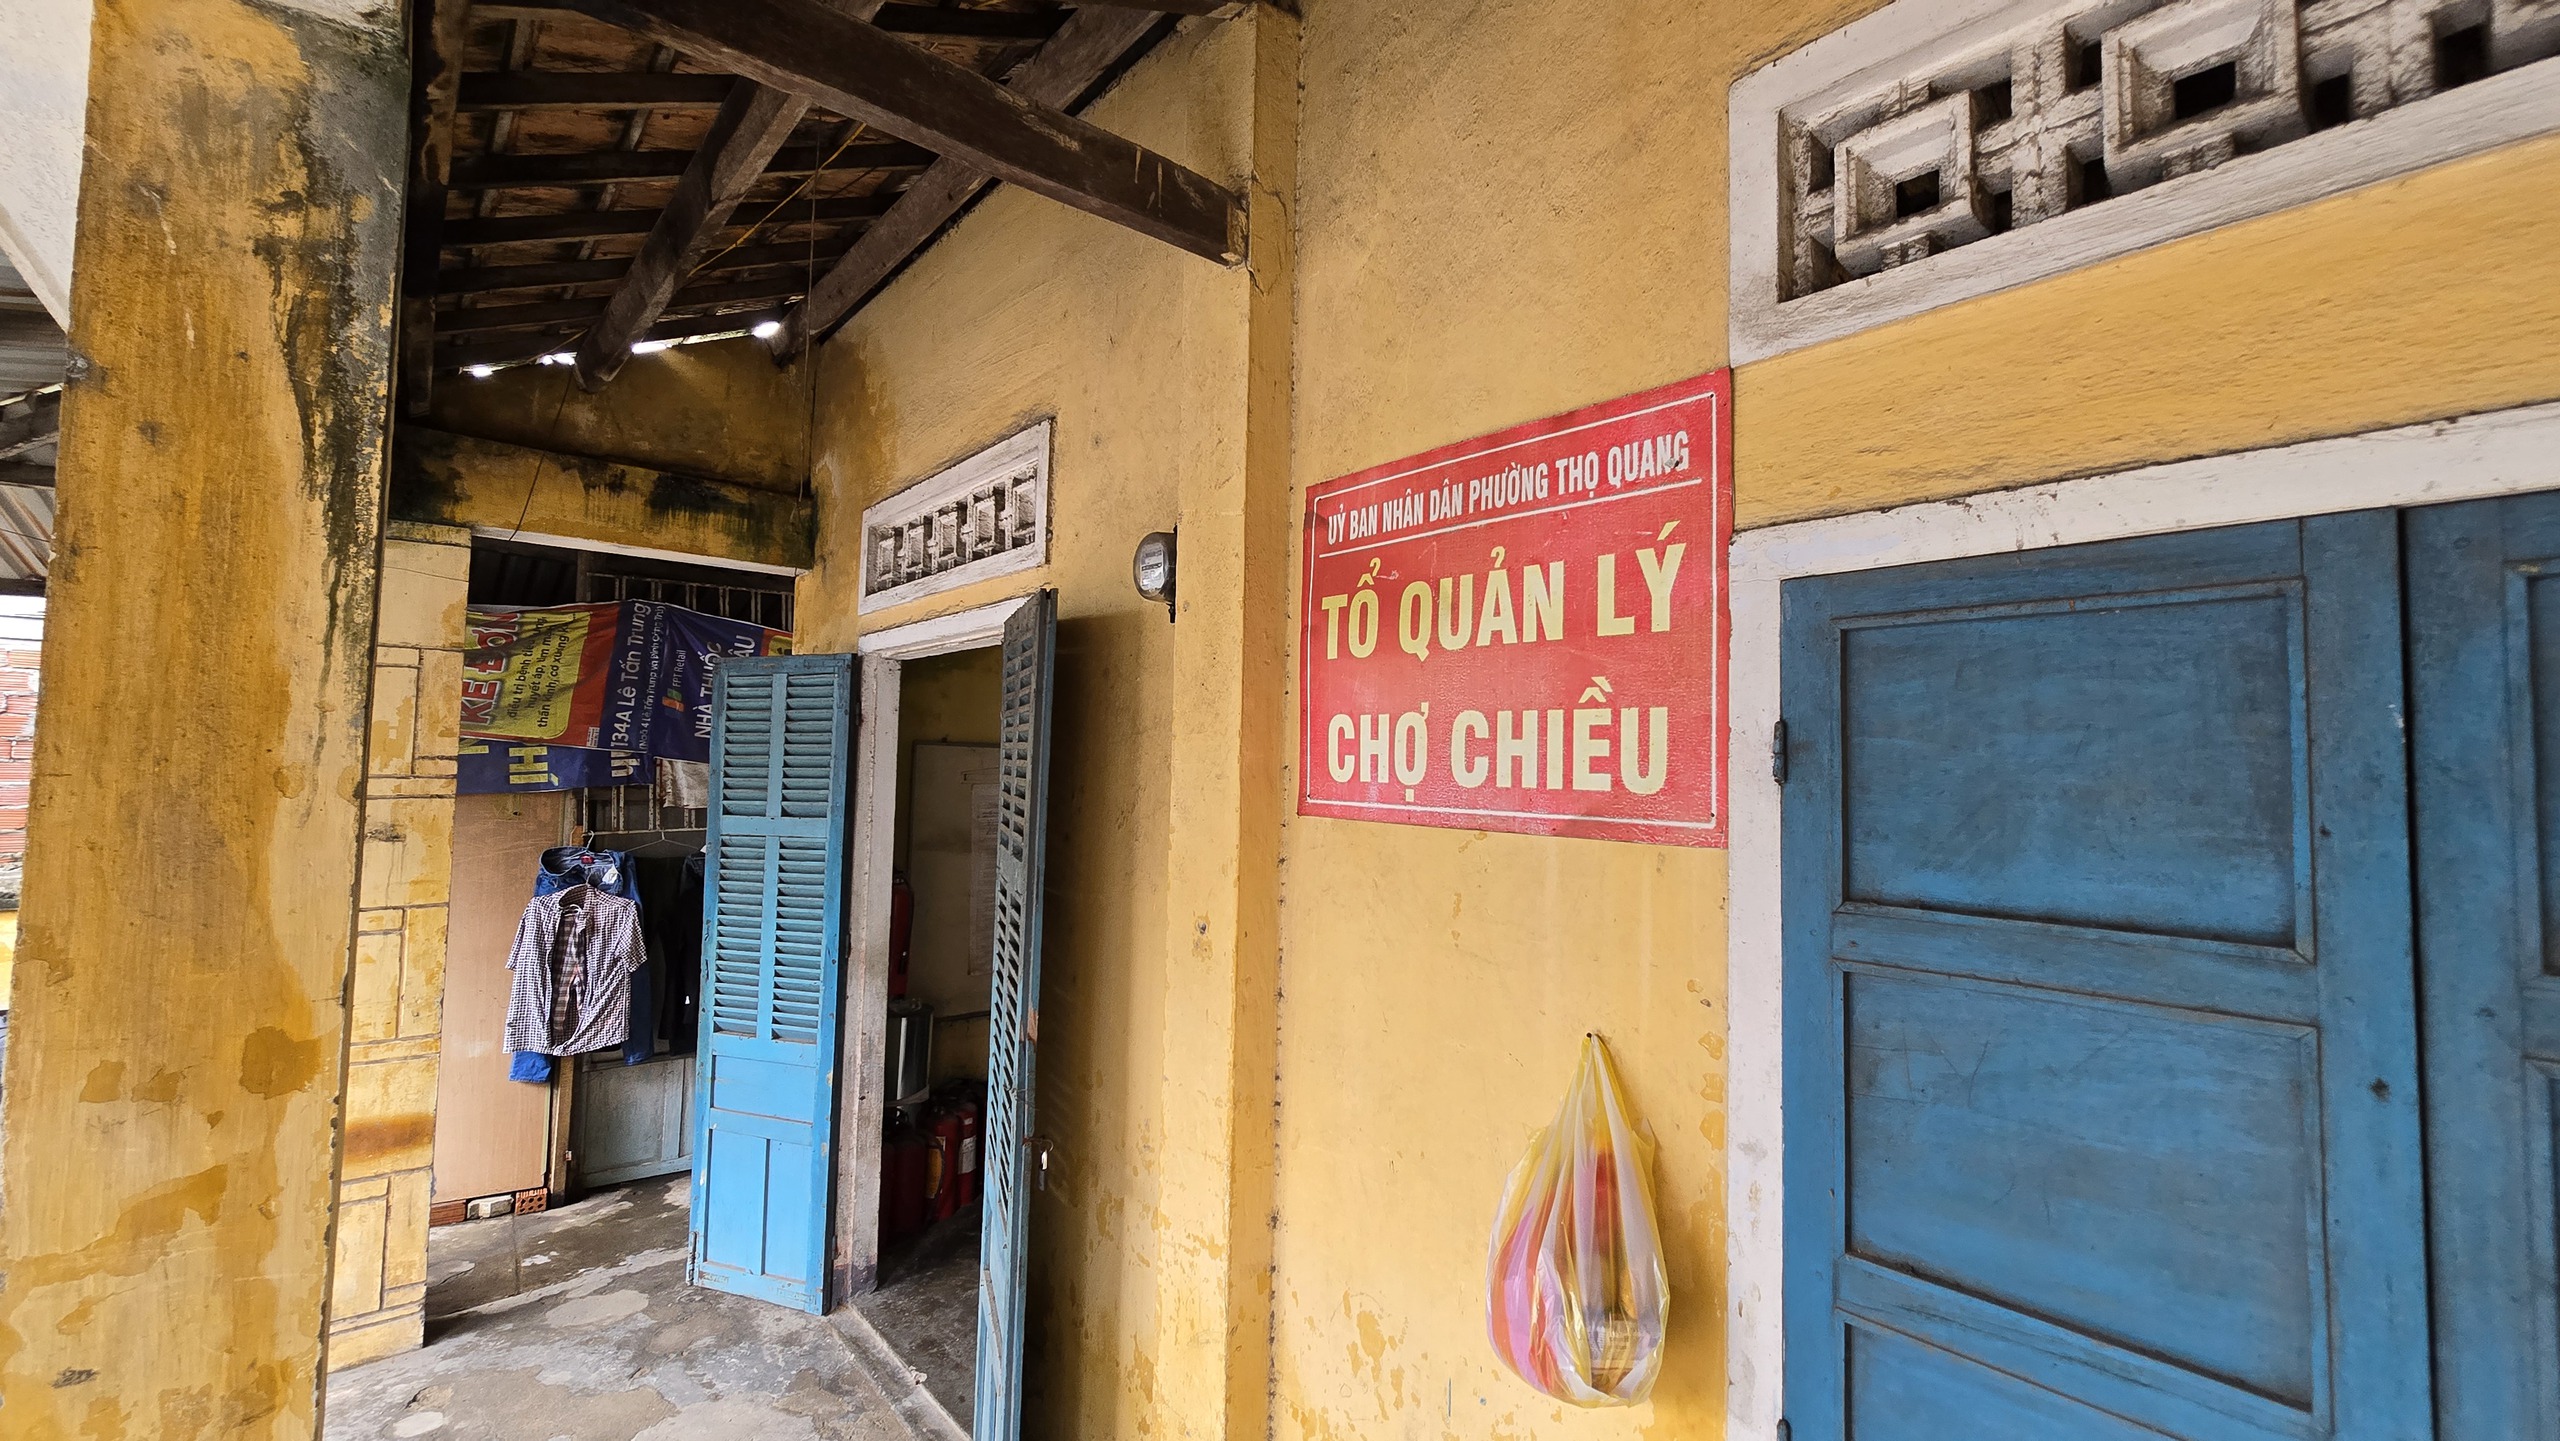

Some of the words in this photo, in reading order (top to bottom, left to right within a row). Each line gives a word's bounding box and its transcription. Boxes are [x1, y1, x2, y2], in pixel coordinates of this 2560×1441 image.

[1327, 503, 1346, 546] UỶ
[1349, 508, 1378, 541] BAN
[1382, 489, 1425, 534] NHÂN
[1429, 478, 1463, 521] DÂN
[1468, 461, 1549, 515] PHƯỜNG
[1555, 451, 1599, 498] THỌ
[1607, 430, 1690, 483] QUANG
[1321, 556, 1381, 661] TỔ
[1398, 545, 1565, 662] QUẢN
[1597, 519, 1686, 637] LÝ
[627, 603, 651, 646] Trung
[618, 651, 642, 682] Tấn
[673, 650, 686, 673] Retail
[617, 686, 636, 707] Lê
[672, 673, 682, 688] FPT
[610, 711, 633, 747] 134A
[1328, 702, 1429, 802] CHỢ
[1451, 676, 1668, 795] CHIỀU
